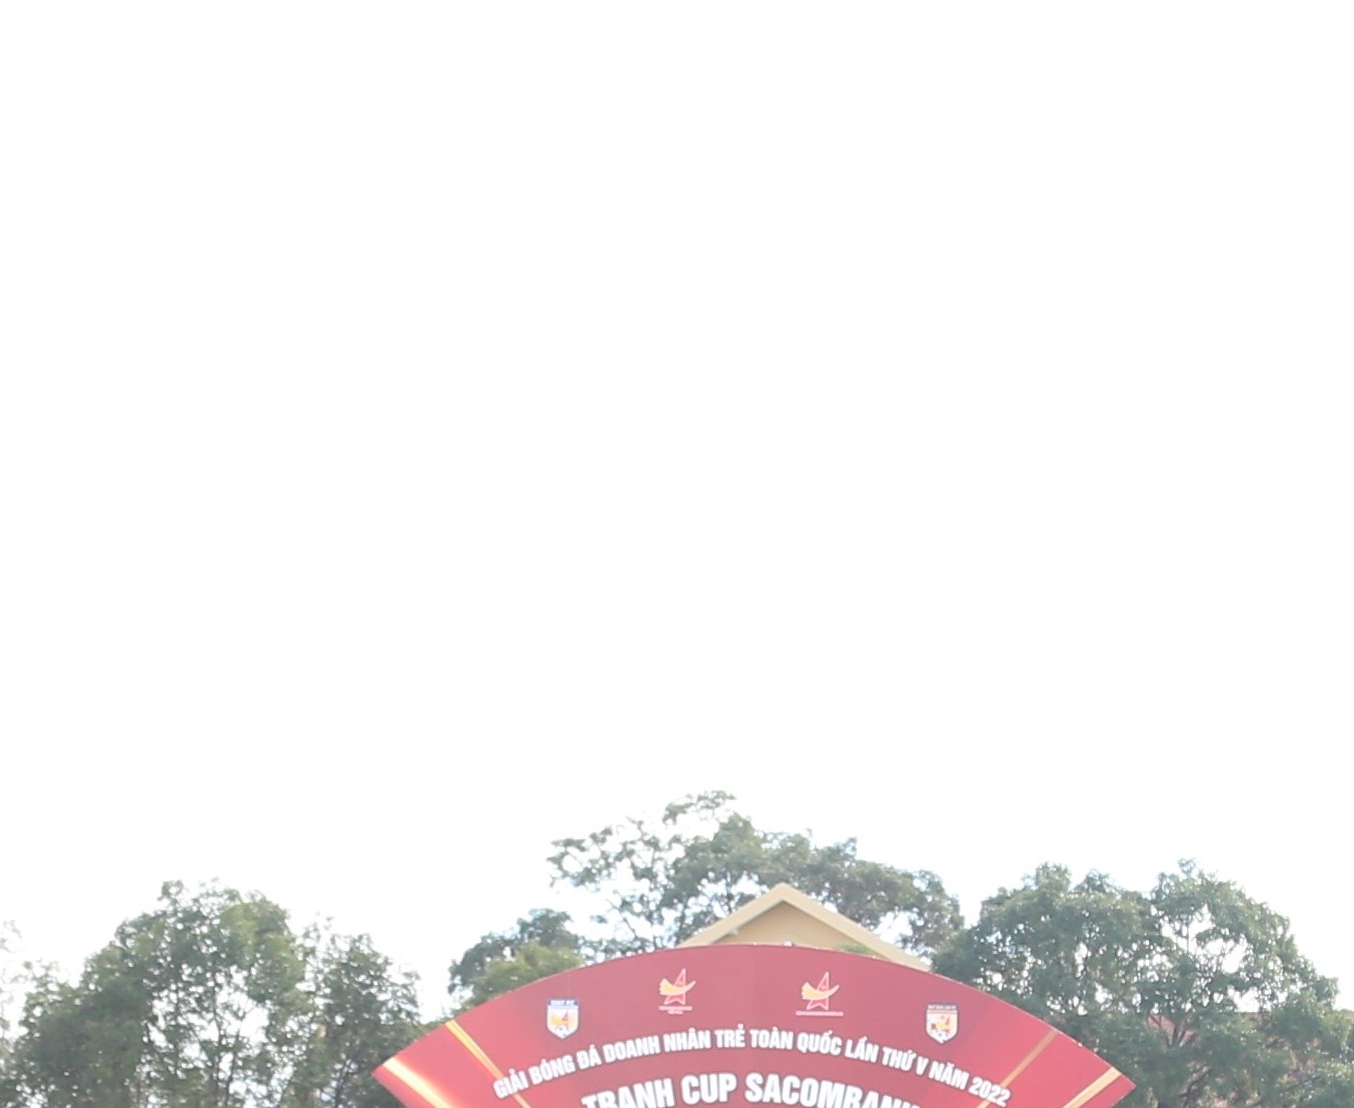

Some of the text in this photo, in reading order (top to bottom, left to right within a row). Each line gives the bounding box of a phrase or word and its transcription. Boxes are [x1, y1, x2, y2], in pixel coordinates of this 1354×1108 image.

[493, 1068, 529, 1099] GIẢI
[528, 1058, 576, 1085] BÓNG
[576, 1045, 602, 1070] ĐÁ
[603, 1034, 660, 1063] DOANH
[663, 1027, 711, 1052] NHÂN
[714, 1024, 745, 1048] TRẺ
[749, 1026, 793, 1050] TOÀN
[797, 1031, 842, 1054] QUỐC
[881, 1047, 916, 1071] THỨ
[916, 1056, 929, 1076] V
[929, 1061, 970, 1089] NĂM
[969, 1076, 1011, 1107] 2022
[680, 1073, 737, 1105] CUP
